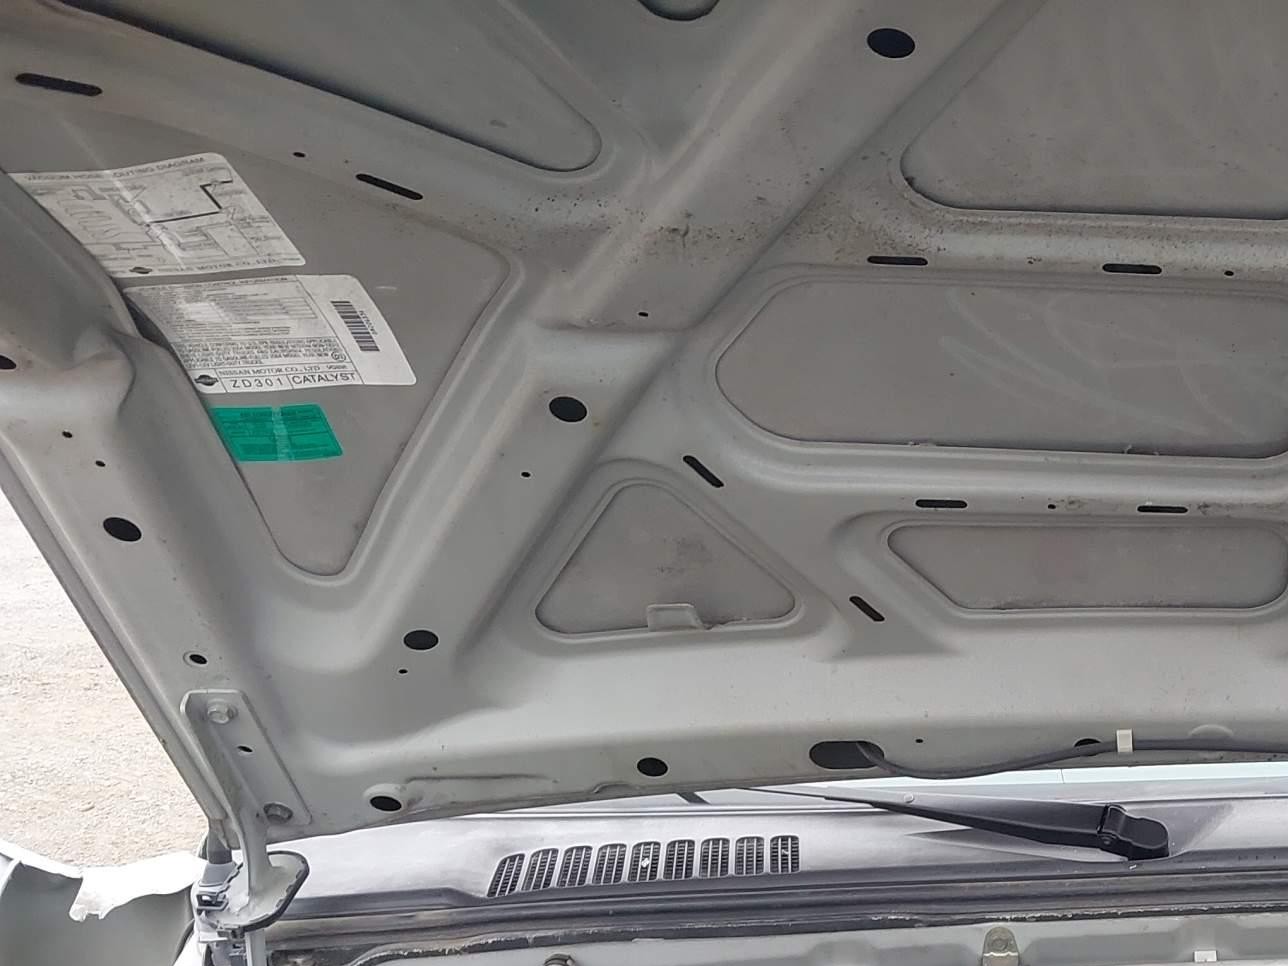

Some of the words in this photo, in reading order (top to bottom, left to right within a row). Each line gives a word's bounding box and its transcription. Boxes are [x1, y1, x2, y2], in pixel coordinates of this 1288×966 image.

[254, 367, 283, 375] MOTOR
[230, 377, 284, 389] ZD301
[292, 372, 357, 385] CATALYST
